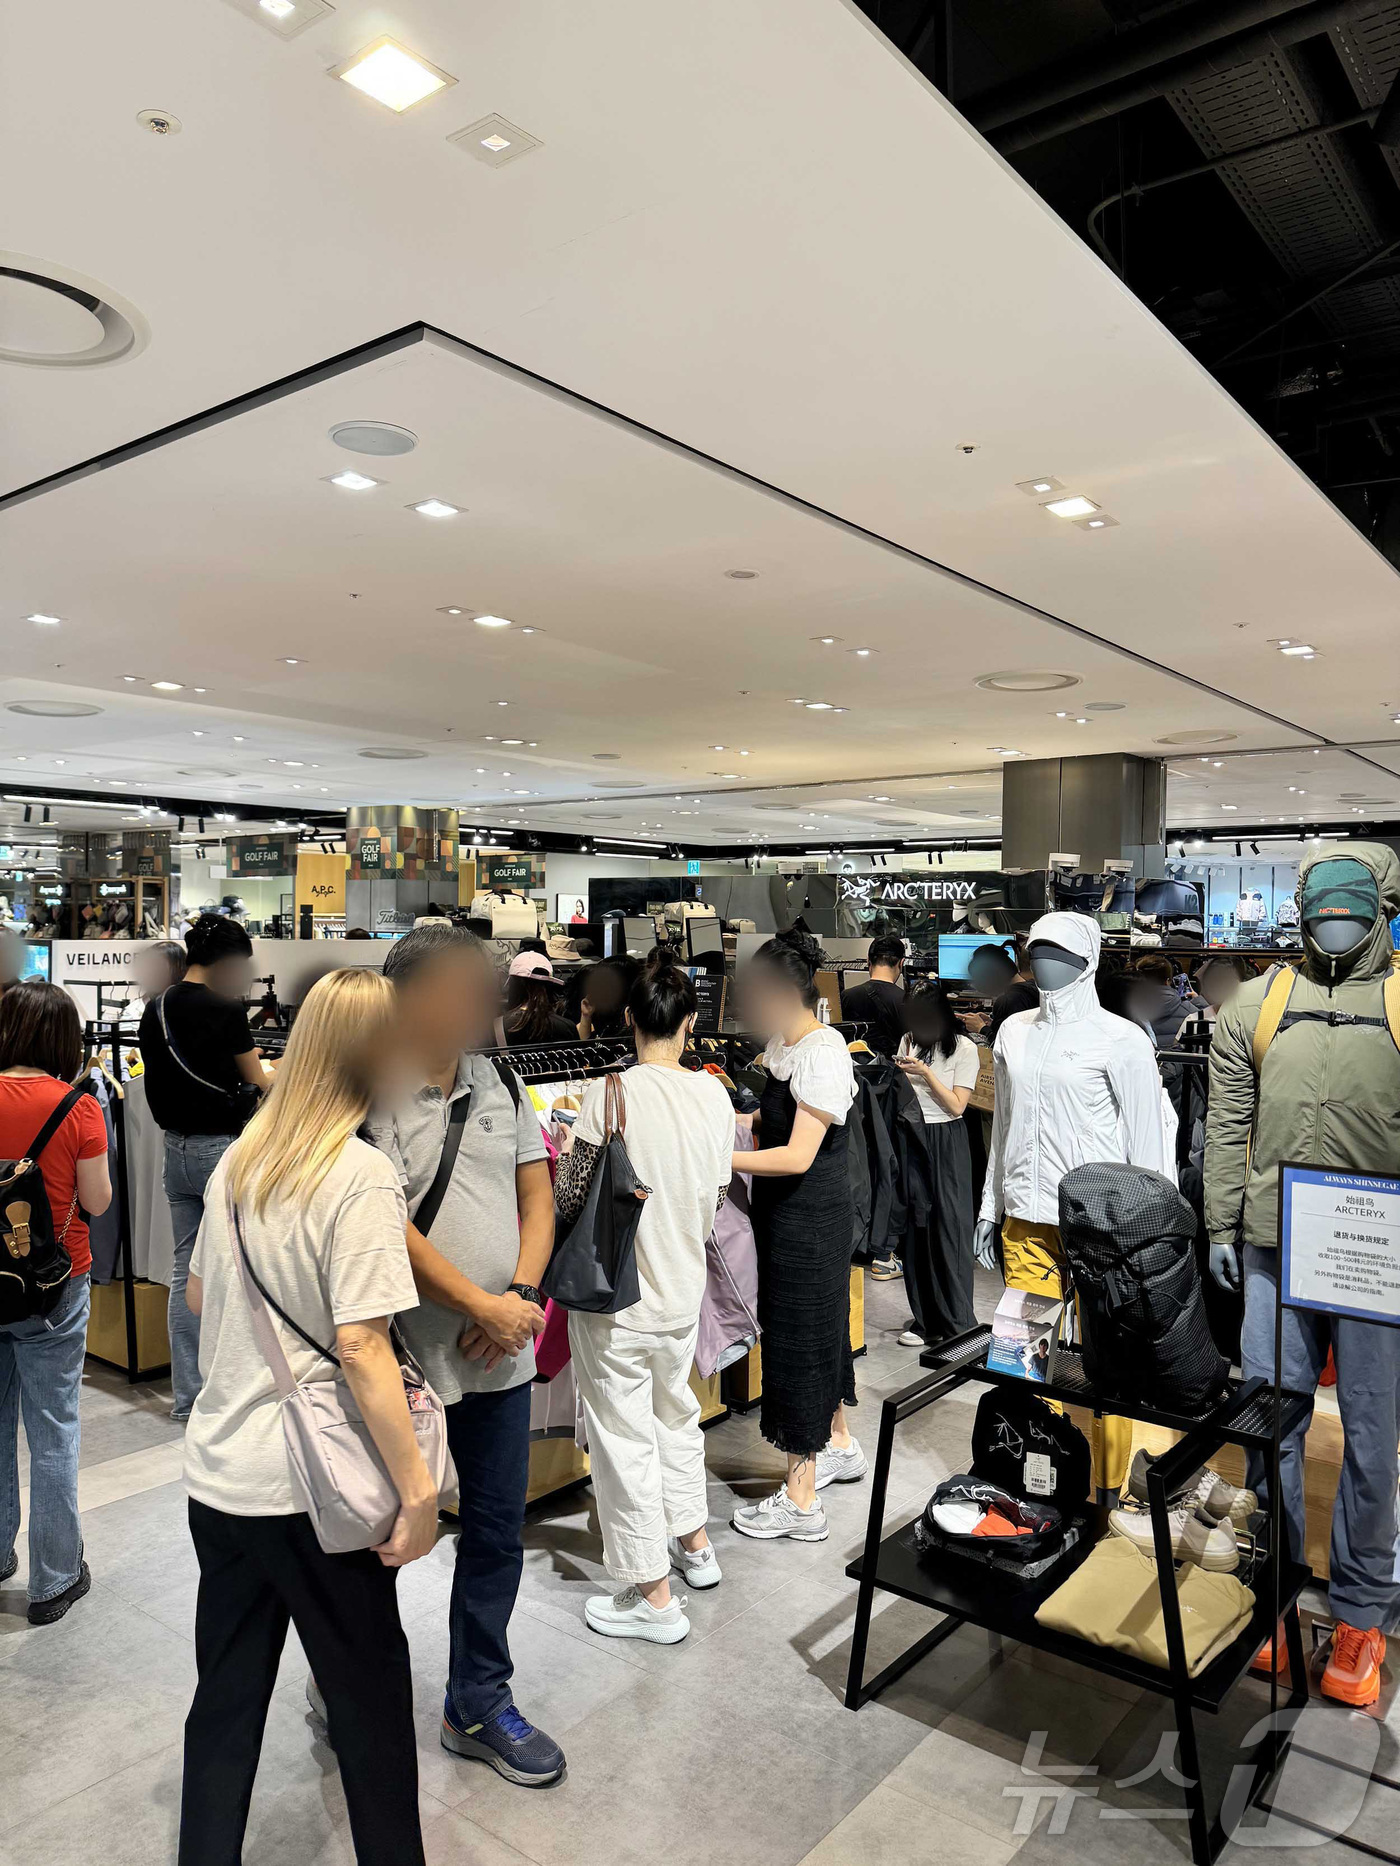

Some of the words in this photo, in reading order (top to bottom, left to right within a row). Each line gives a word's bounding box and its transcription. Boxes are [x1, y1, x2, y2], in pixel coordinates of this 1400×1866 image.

[361, 844, 380, 854] GOLF
[245, 852, 263, 862] GOLF
[263, 851, 278, 861] FAIR
[363, 853, 378, 862] FAIR
[138, 863, 154, 872] GOLF
[494, 869, 512, 877] GOLF
[512, 868, 526, 876] FAIR
[881, 881, 976, 899] ARC'TERYX
[1323, 1175, 1353, 1185] ALWAYS
[1353, 1178, 1400, 1190] SHINSEGAE
[1345, 1195, 1375, 1207] 始祖鸟
[1334, 1205, 1386, 1219] ARCTERYX
